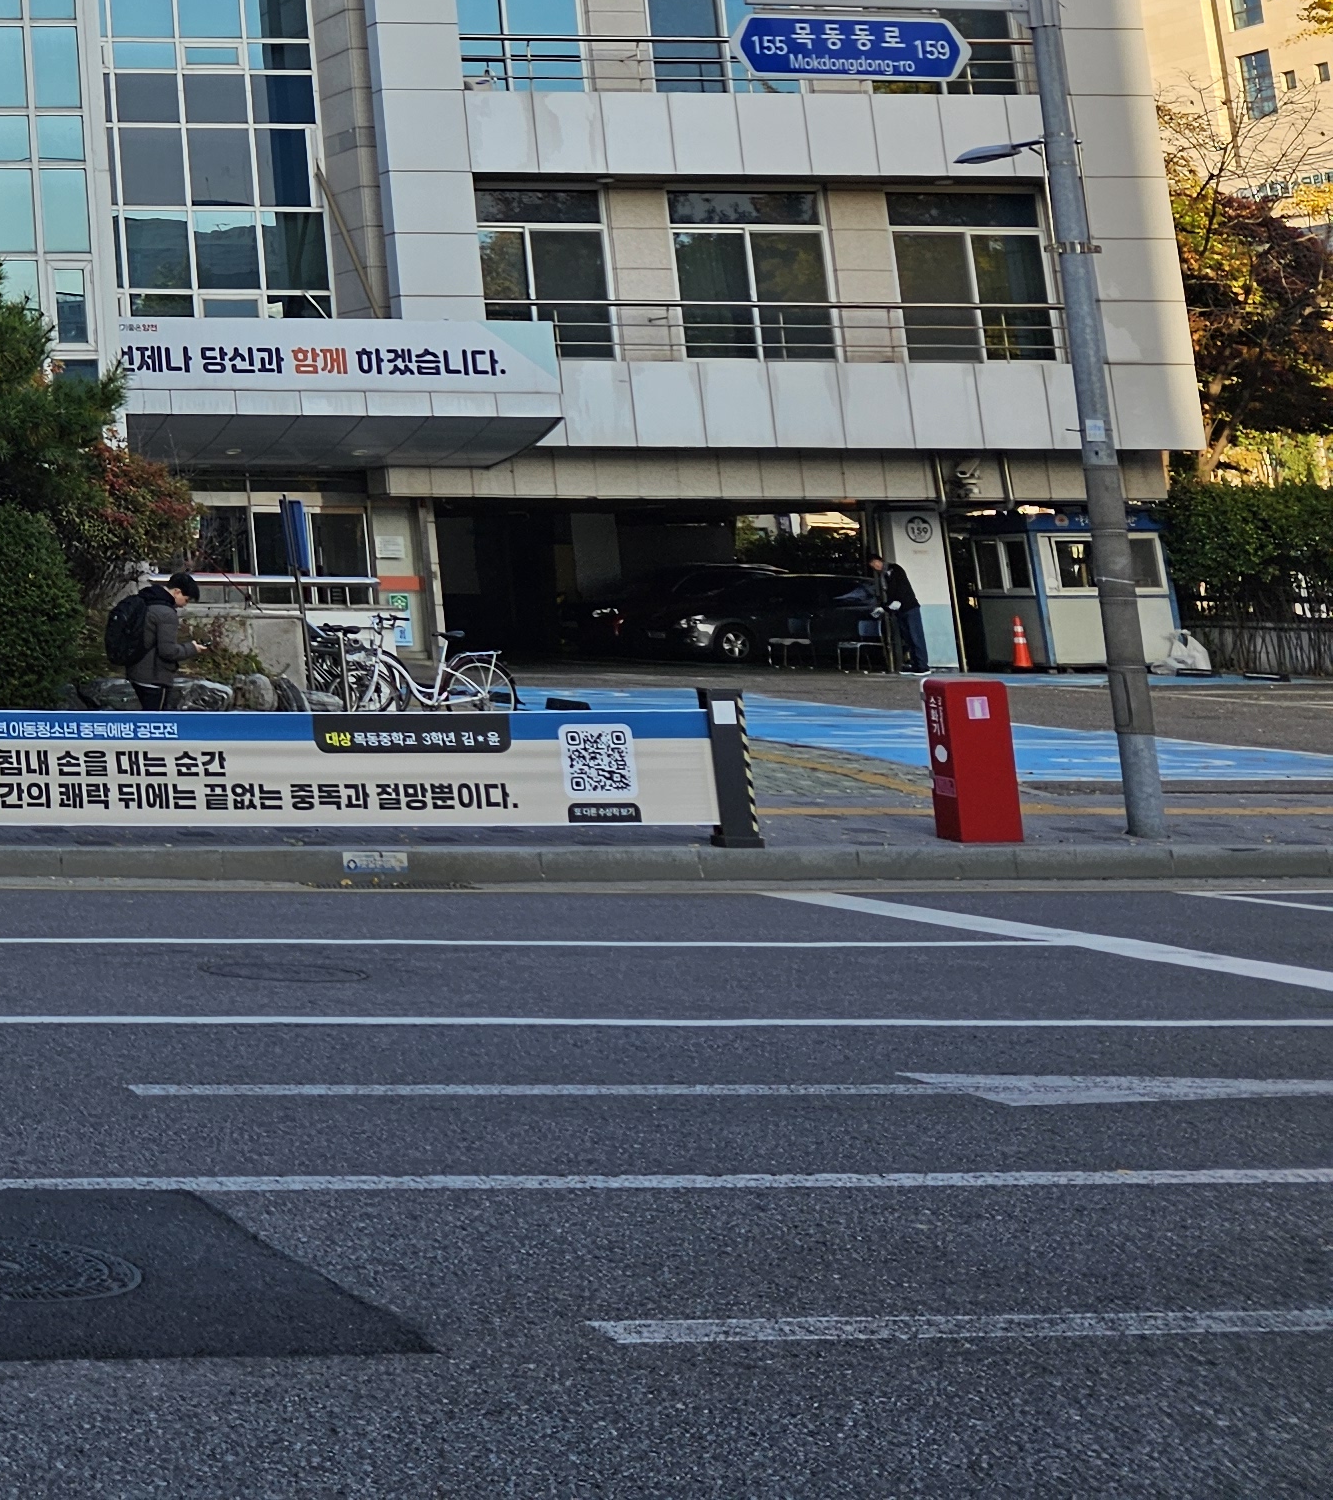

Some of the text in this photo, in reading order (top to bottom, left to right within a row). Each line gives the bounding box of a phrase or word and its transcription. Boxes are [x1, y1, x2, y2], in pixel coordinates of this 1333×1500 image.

[751, 36, 788, 55] 155
[791, 23, 906, 50] 목동동로
[914, 40, 950, 60] 159
[789, 54, 915, 75] Mokdongdong-ro
[200, 345, 284, 374] 당신과
[291, 347, 349, 375] 함께
[355, 346, 507, 376] 하겠습니다.
[9, 721, 78, 738] 아동청소년
[80, 722, 134, 739] 중독예방
[137, 722, 178, 739] 공모전
[325, 731, 351, 747] 대상
[353, 731, 418, 747] 목동중학교
[422, 731, 456, 747] 3학년
[56, 750, 108, 777] 손을
[115, 750, 167, 777] 대는
[174, 750, 226, 778] 순간
[58, 782, 110, 810] 쾌락
[117, 782, 197, 810] 뒤에는
[204, 782, 283, 810] 끝없는
[289, 782, 370, 811] 중독과
[375, 782, 519, 811] 절망뿐이다.
